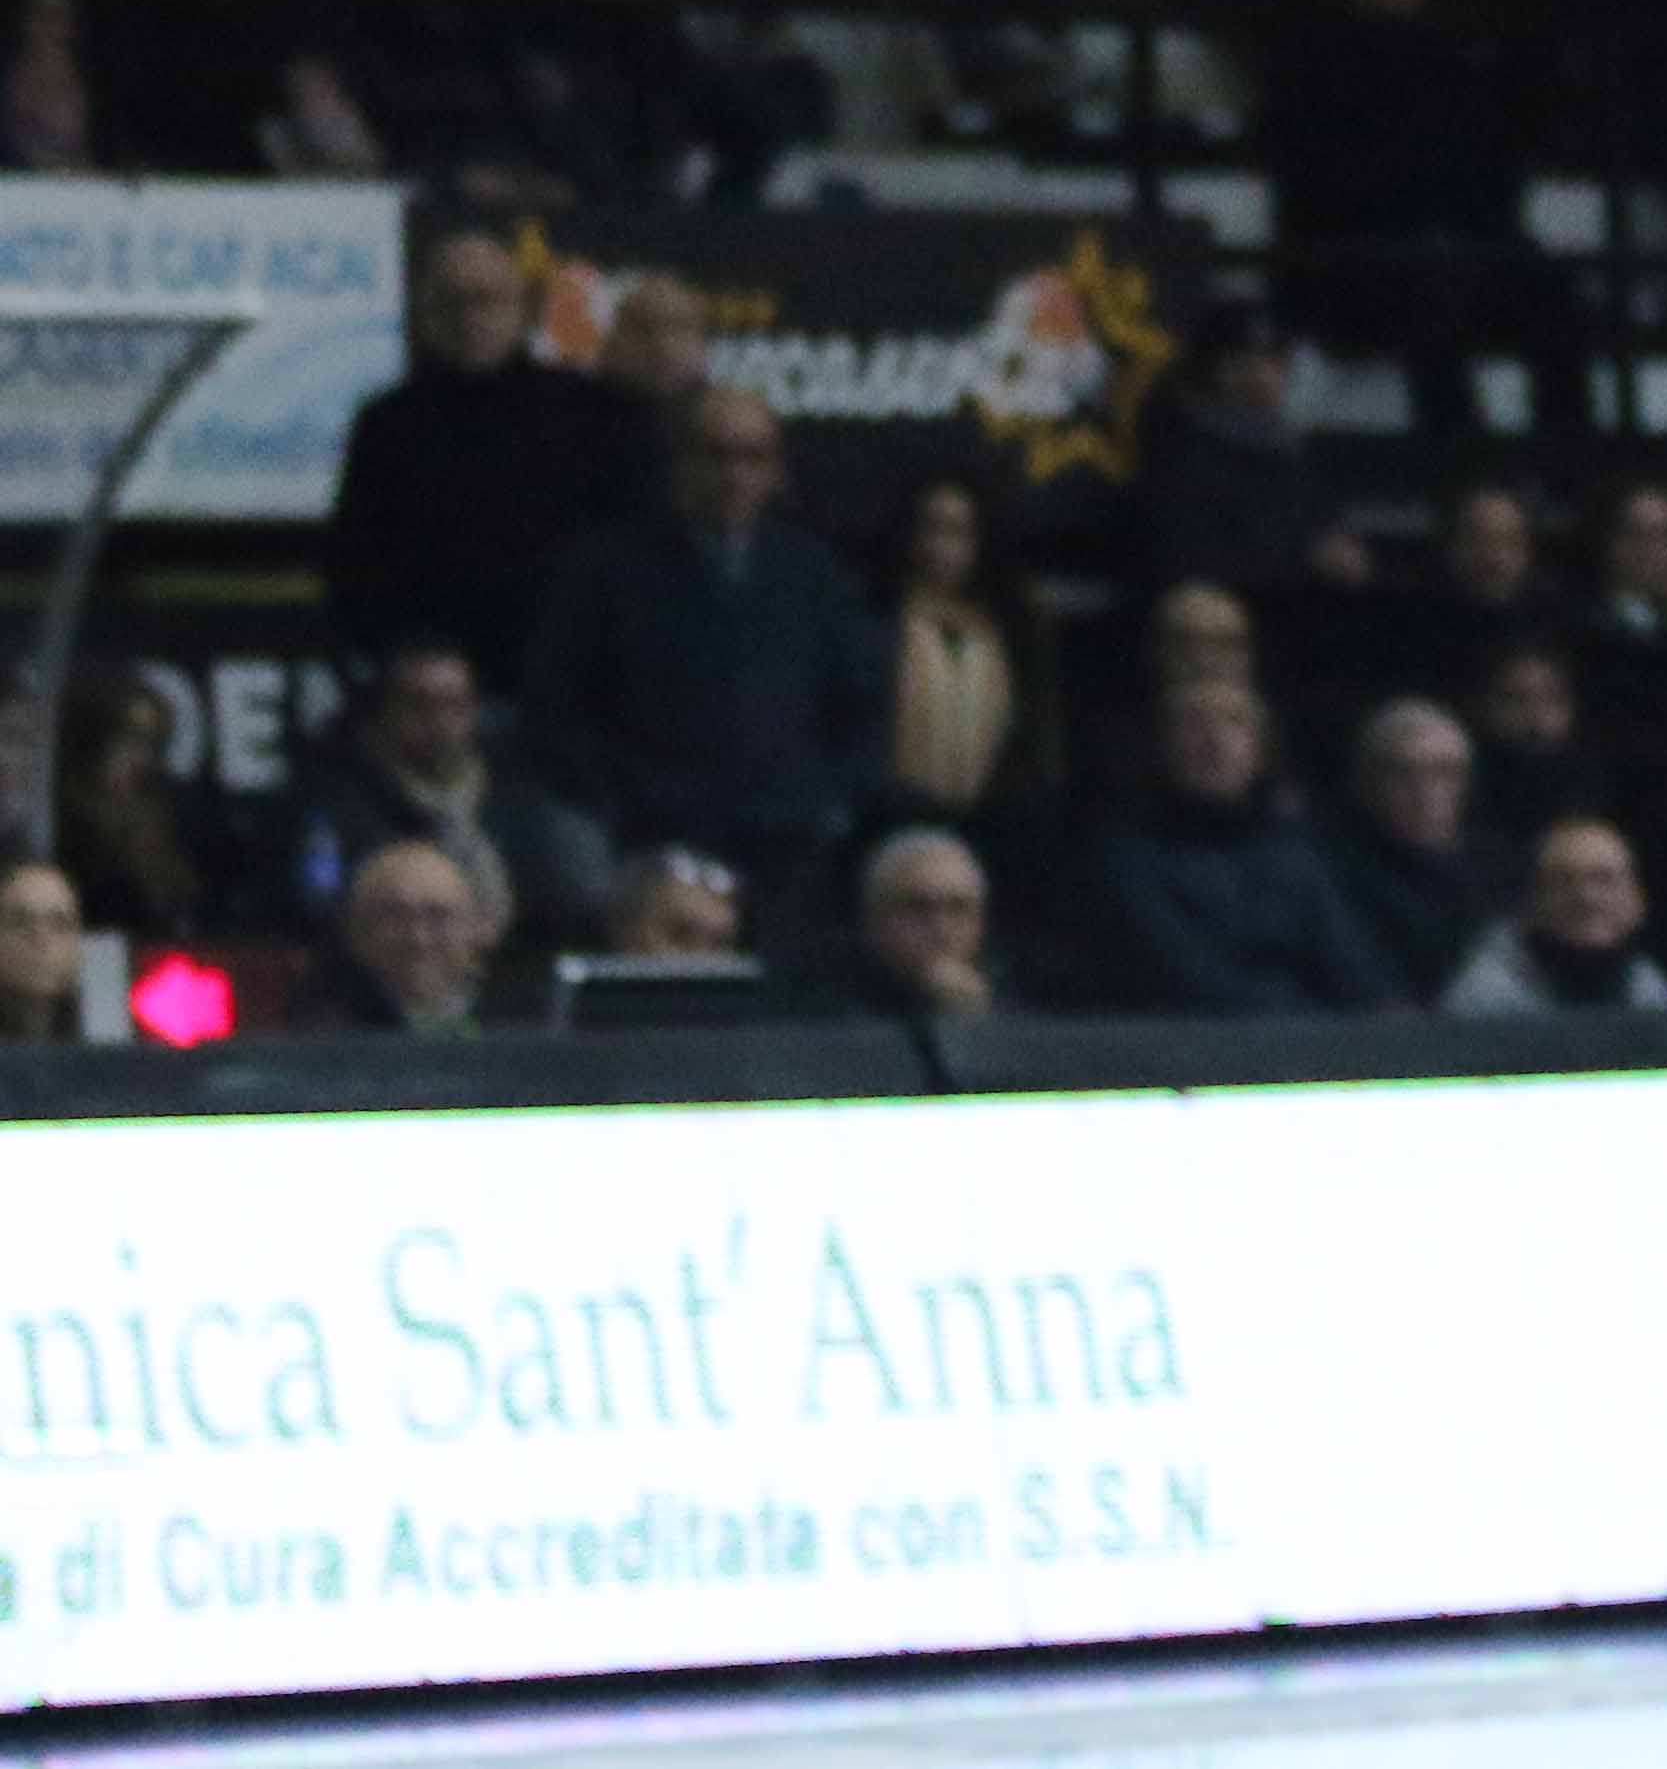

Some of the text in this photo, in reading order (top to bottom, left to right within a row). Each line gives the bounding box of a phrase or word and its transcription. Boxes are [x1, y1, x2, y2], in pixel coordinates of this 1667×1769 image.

[376, 1206, 750, 1440] Sant'
[798, 1216, 1190, 1424] Anna
[52, 1510, 126, 1620] di
[155, 1506, 350, 1616] Cura
[377, 1486, 824, 1604] Accreditata
[846, 1492, 990, 1578] con
